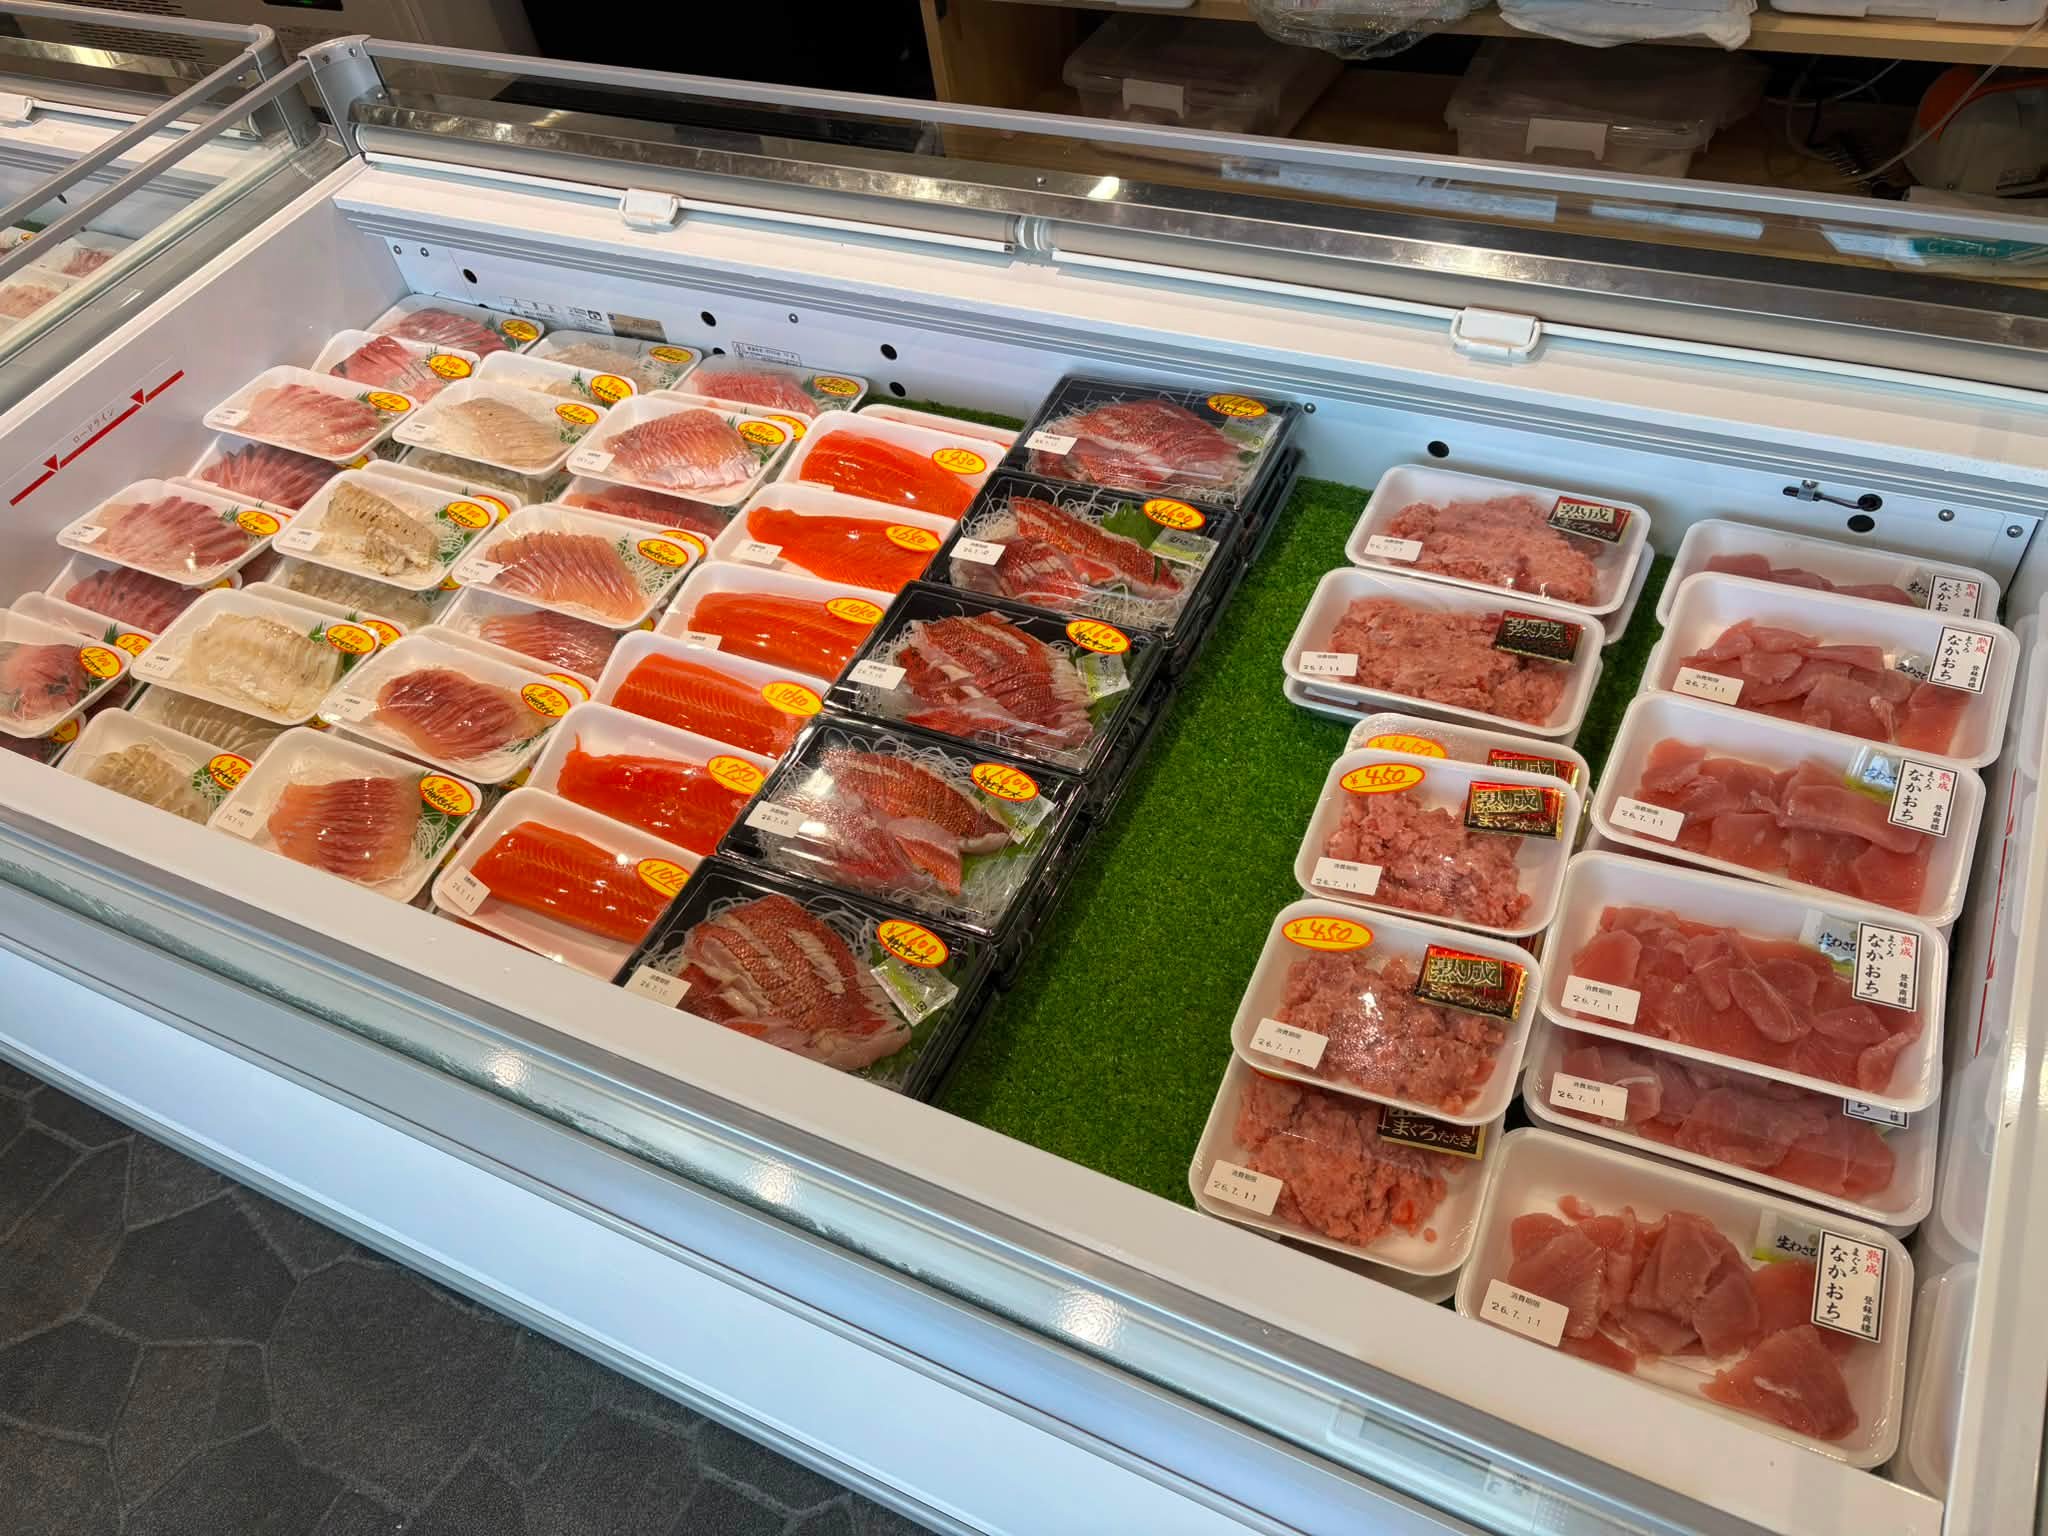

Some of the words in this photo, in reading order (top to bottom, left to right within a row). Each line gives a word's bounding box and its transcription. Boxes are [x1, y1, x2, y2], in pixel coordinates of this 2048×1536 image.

[1939, 634, 1963, 682] なかおち
[1350, 768, 1406, 786] ¥450
[1473, 789, 1539, 814] 熟成
[1902, 768, 1924, 821] なかおち
[1293, 919, 1354, 942] ¥450
[1900, 935, 1914, 960] 熟成
[1429, 957, 1498, 986] 熟成
[1864, 933, 1885, 995] なかおち
[1391, 1117, 1477, 1149] まぐろたたき
[1849, 1246, 1863, 1276] まぐろ
[1864, 1248, 1881, 1279] 熟成
[1825, 1244, 1849, 1321] なかおち
[1490, 1299, 1543, 1329] 26.7.11
